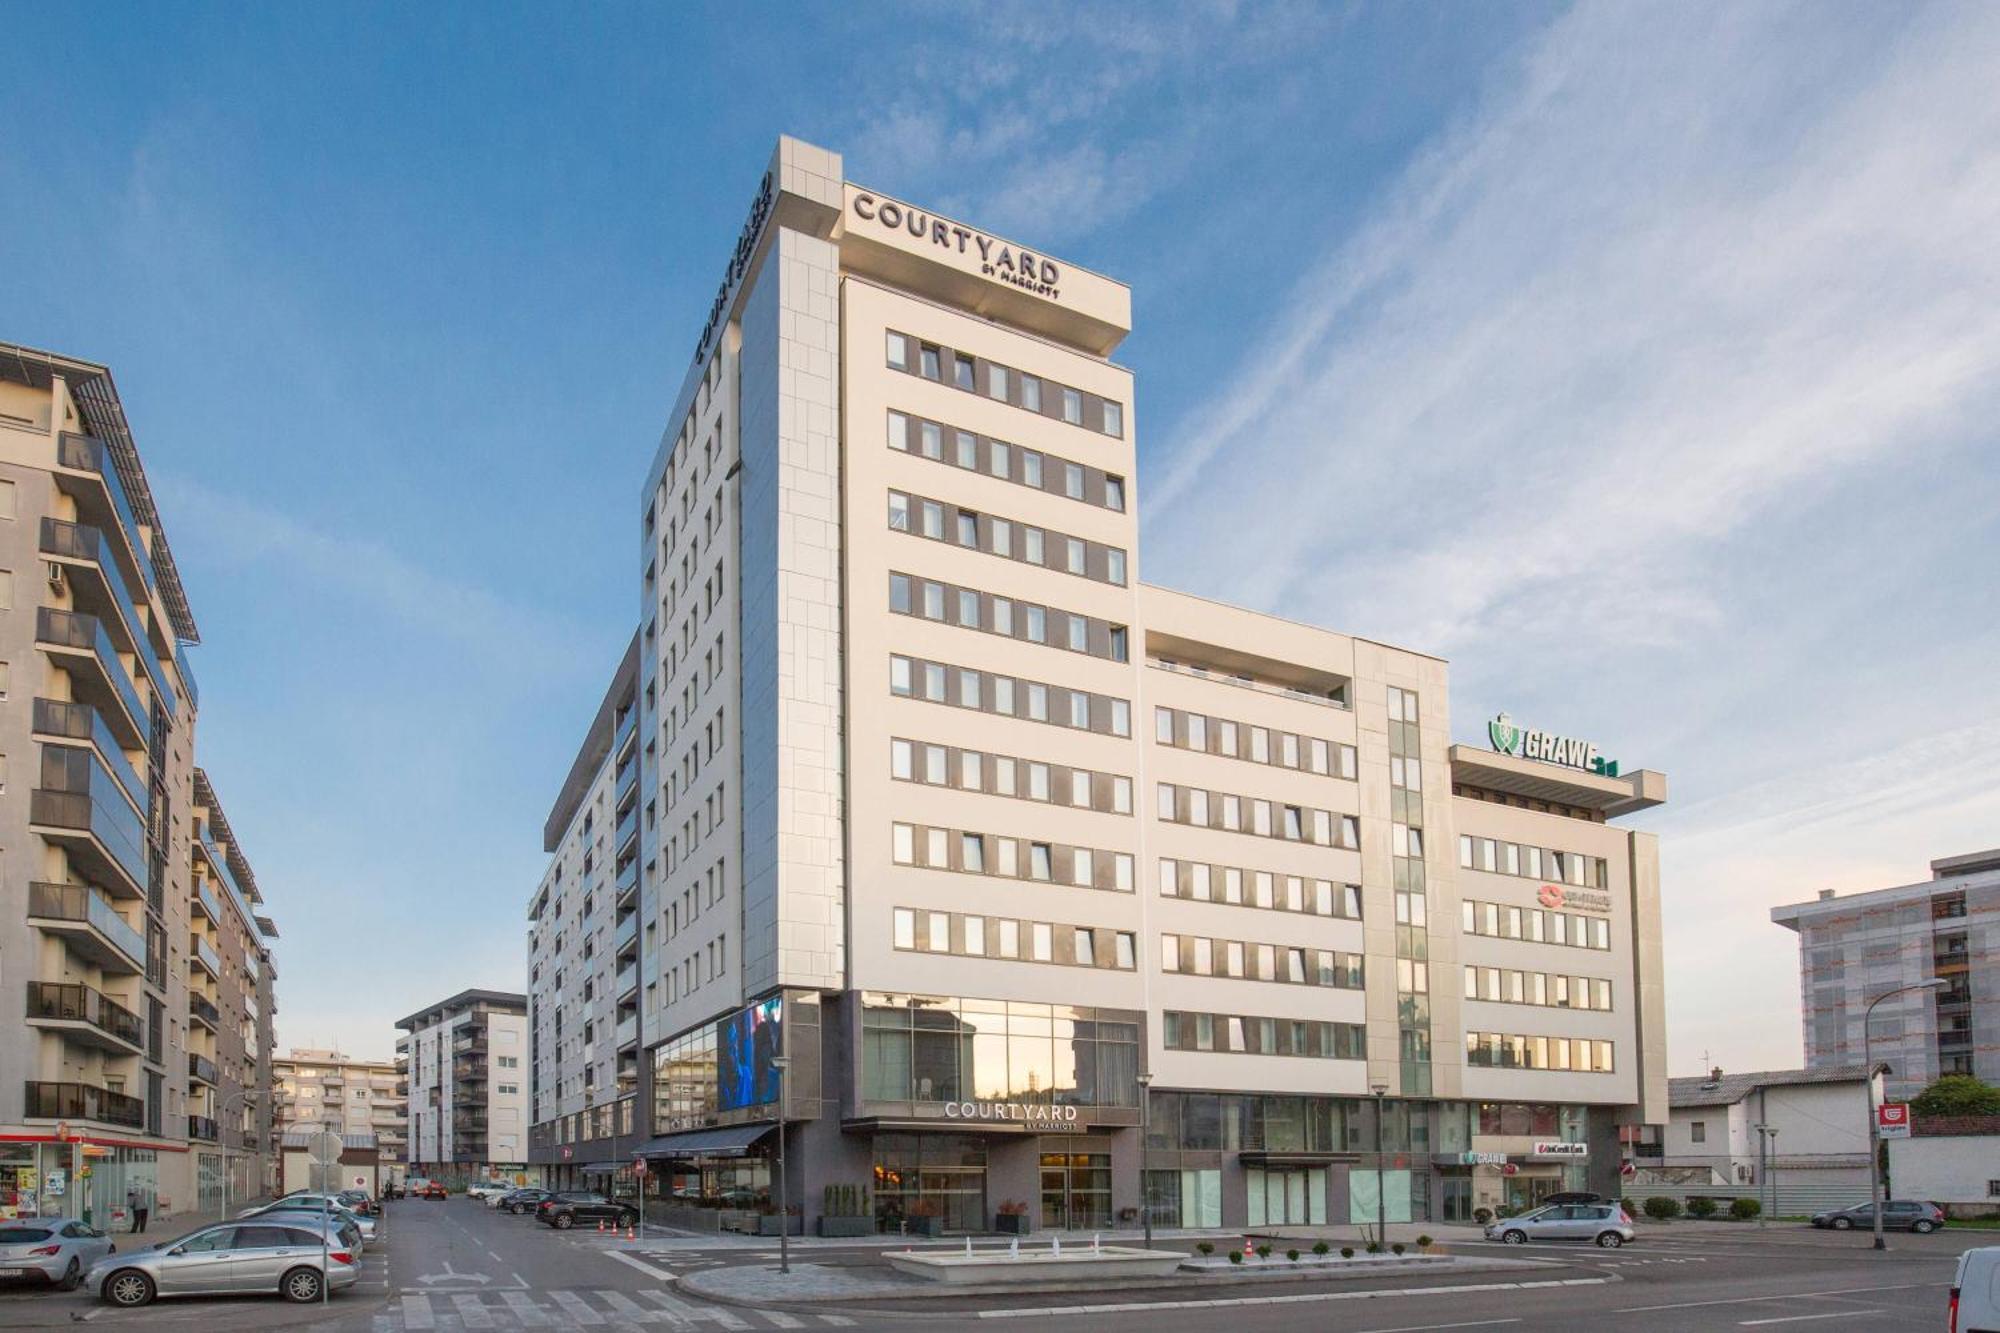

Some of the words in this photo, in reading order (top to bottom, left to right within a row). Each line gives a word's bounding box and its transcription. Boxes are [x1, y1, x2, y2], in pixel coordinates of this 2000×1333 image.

[854, 193, 1060, 285] COURTYARD
[982, 263, 996, 276] BY
[1001, 270, 1061, 299] MARRIOTT
[1523, 729, 1603, 774] GRAWE
[945, 1102, 1077, 1120] COURTYARD
[1039, 1123, 1077, 1131] MARRIOTT
